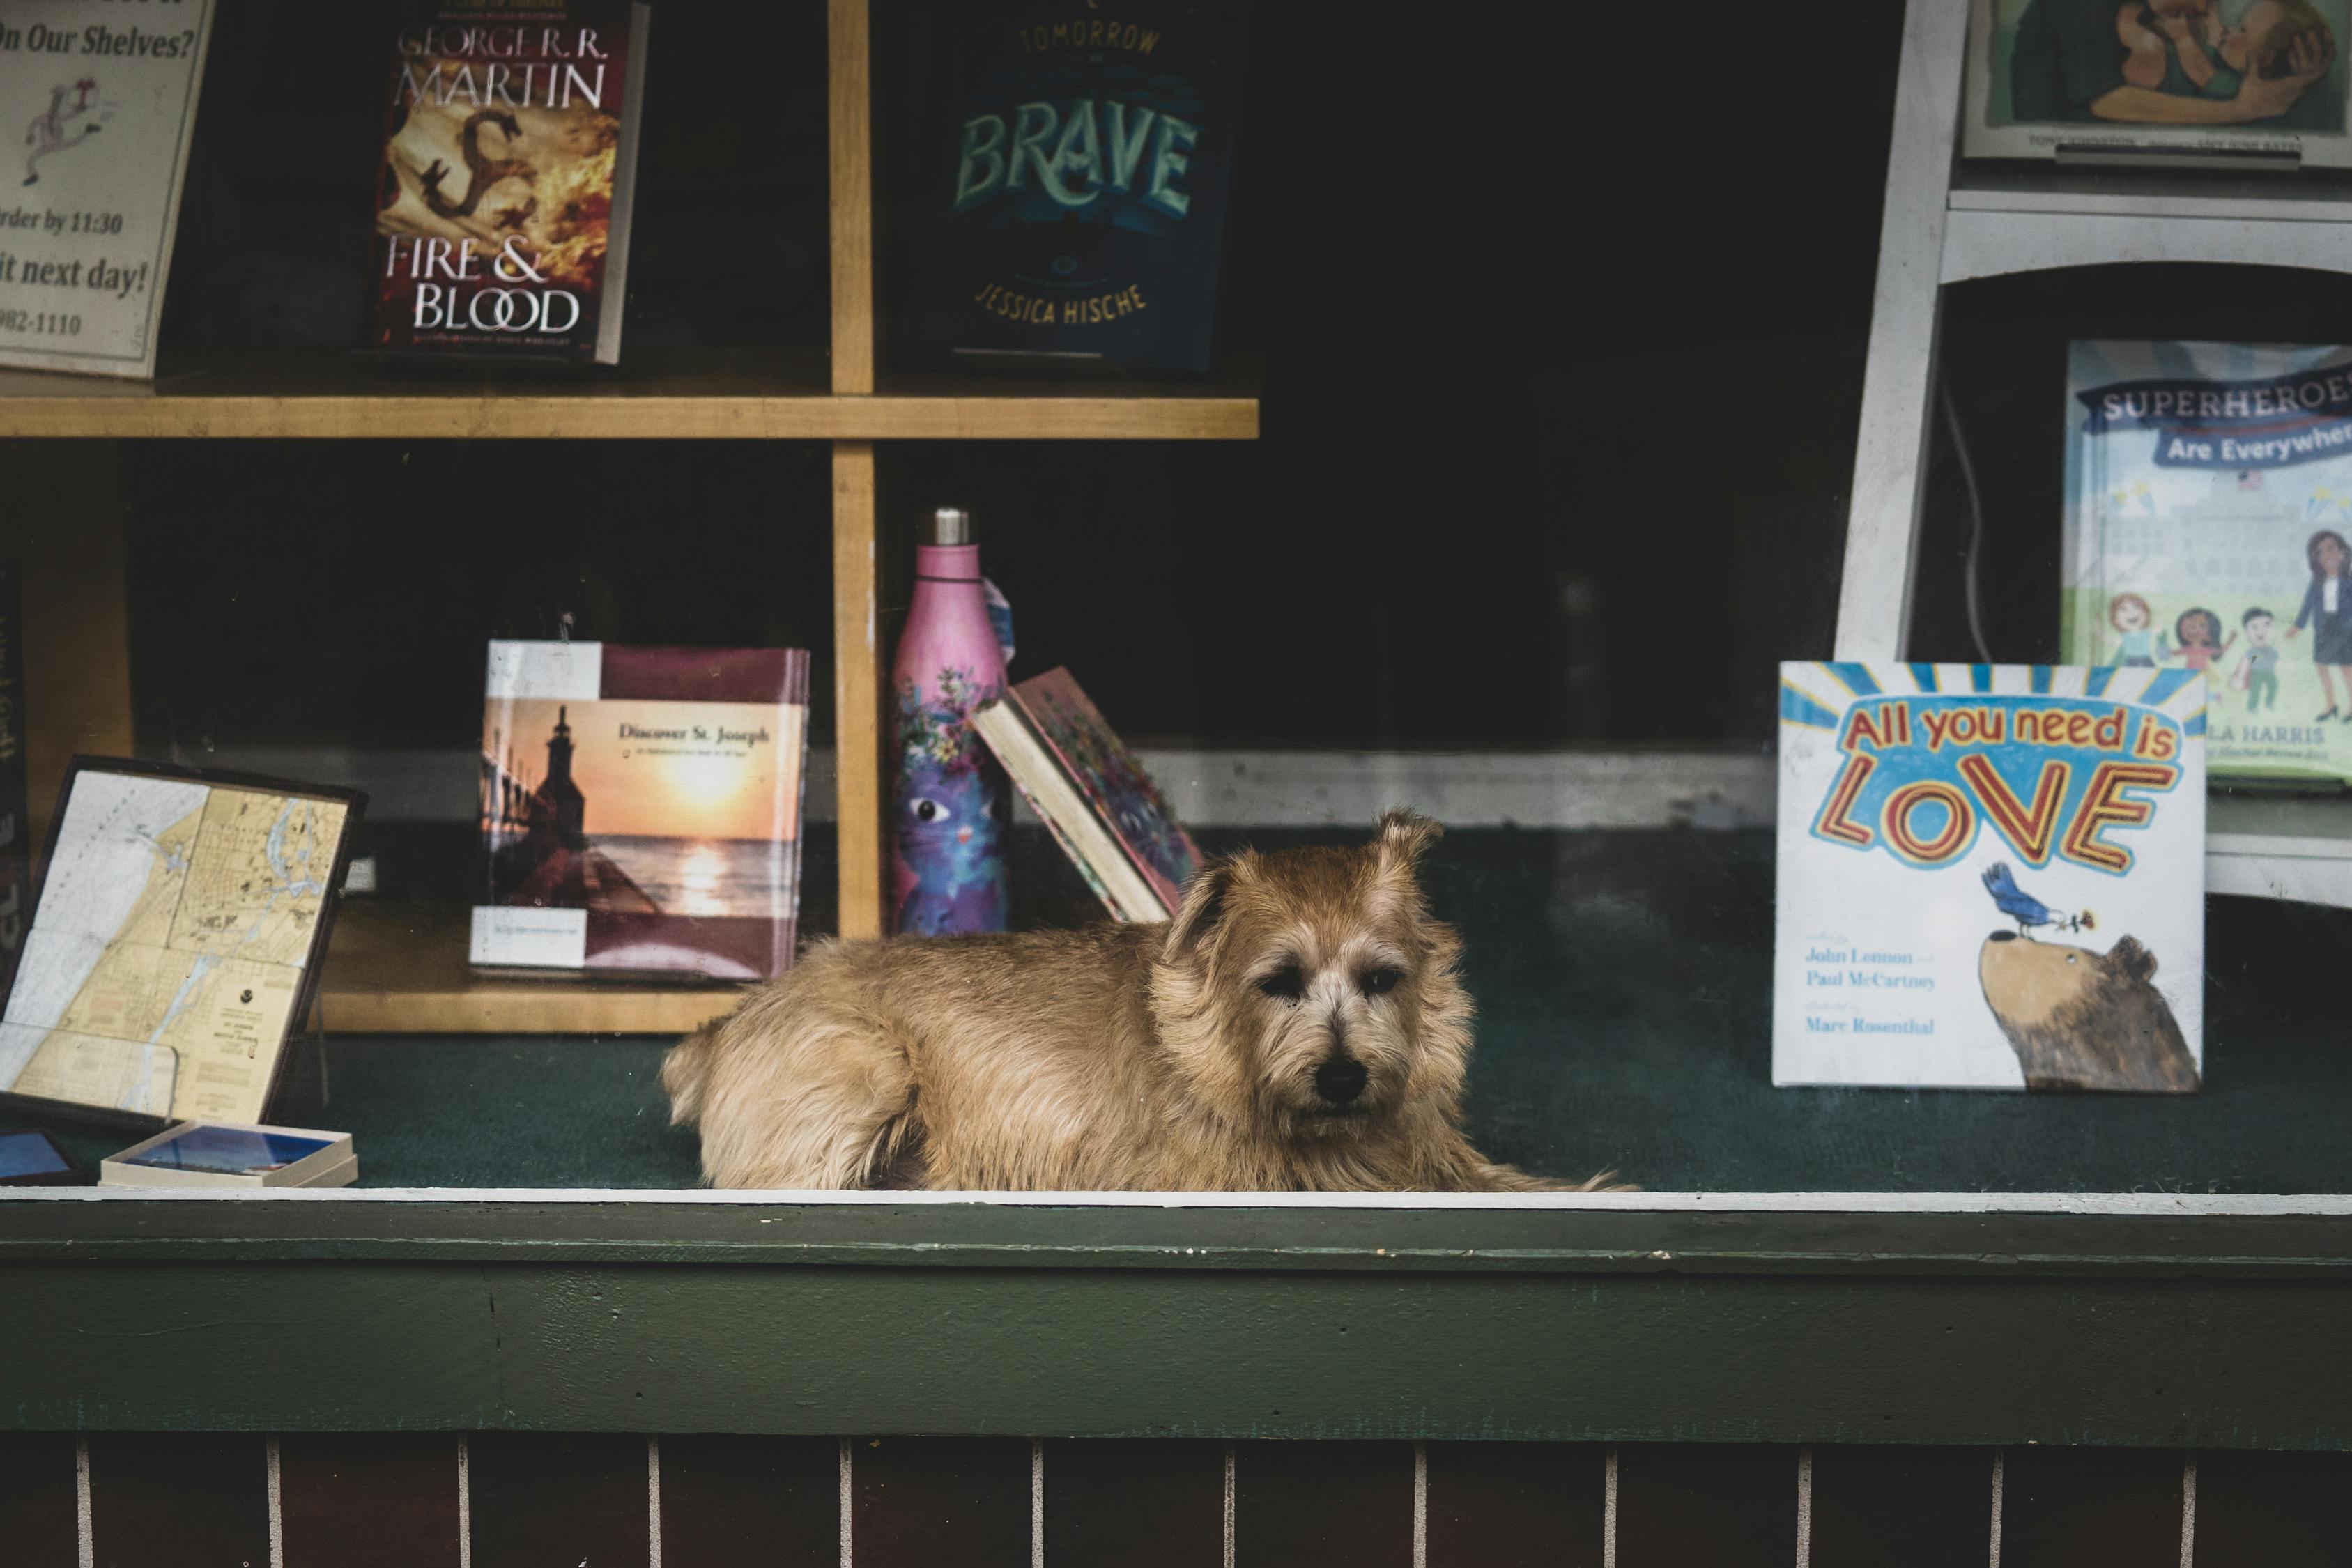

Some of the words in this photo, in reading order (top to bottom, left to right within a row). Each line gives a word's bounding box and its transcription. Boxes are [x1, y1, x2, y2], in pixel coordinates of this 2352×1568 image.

[28, 23, 78, 53] Our
[79, 25, 195, 59] Shelves?
[396, 25, 525, 57] GEORGE
[540, 26, 570, 58] R.
[577, 26, 608, 59] R.
[1018, 20, 1162, 55] TOMORROW
[394, 63, 606, 109] MARTIN
[953, 98, 1200, 215] BRAVE
[43, 208, 68, 237] by
[72, 211, 123, 236] 11:30
[386, 233, 482, 281] FIRE
[493, 234, 550, 284] &
[20, 258, 81, 288] next
[86, 256, 148, 300] day!
[413, 282, 581, 334] BLOOD
[974, 282, 1055, 325] JESSICA
[1063, 283, 1148, 325] HISCHE
[2167, 438, 2213, 460] Are
[619, 722, 686, 740] Discover
[1842, 701, 1911, 751] All
[1921, 705, 2005, 753] you
[2015, 707, 2126, 748] need
[2134, 715, 2177, 760] is
[2242, 724, 2325, 744] HARRIS
[1815, 753, 2178, 873] LOVE
[1806, 946, 1847, 964] John
[1851, 947, 1913, 964] Lennon
[1806, 969, 1843, 986] Paul
[1849, 970, 1935, 993] McCartney
[1806, 1016, 1847, 1033] Marc
[1852, 1017, 1935, 1034] Rosenthal
